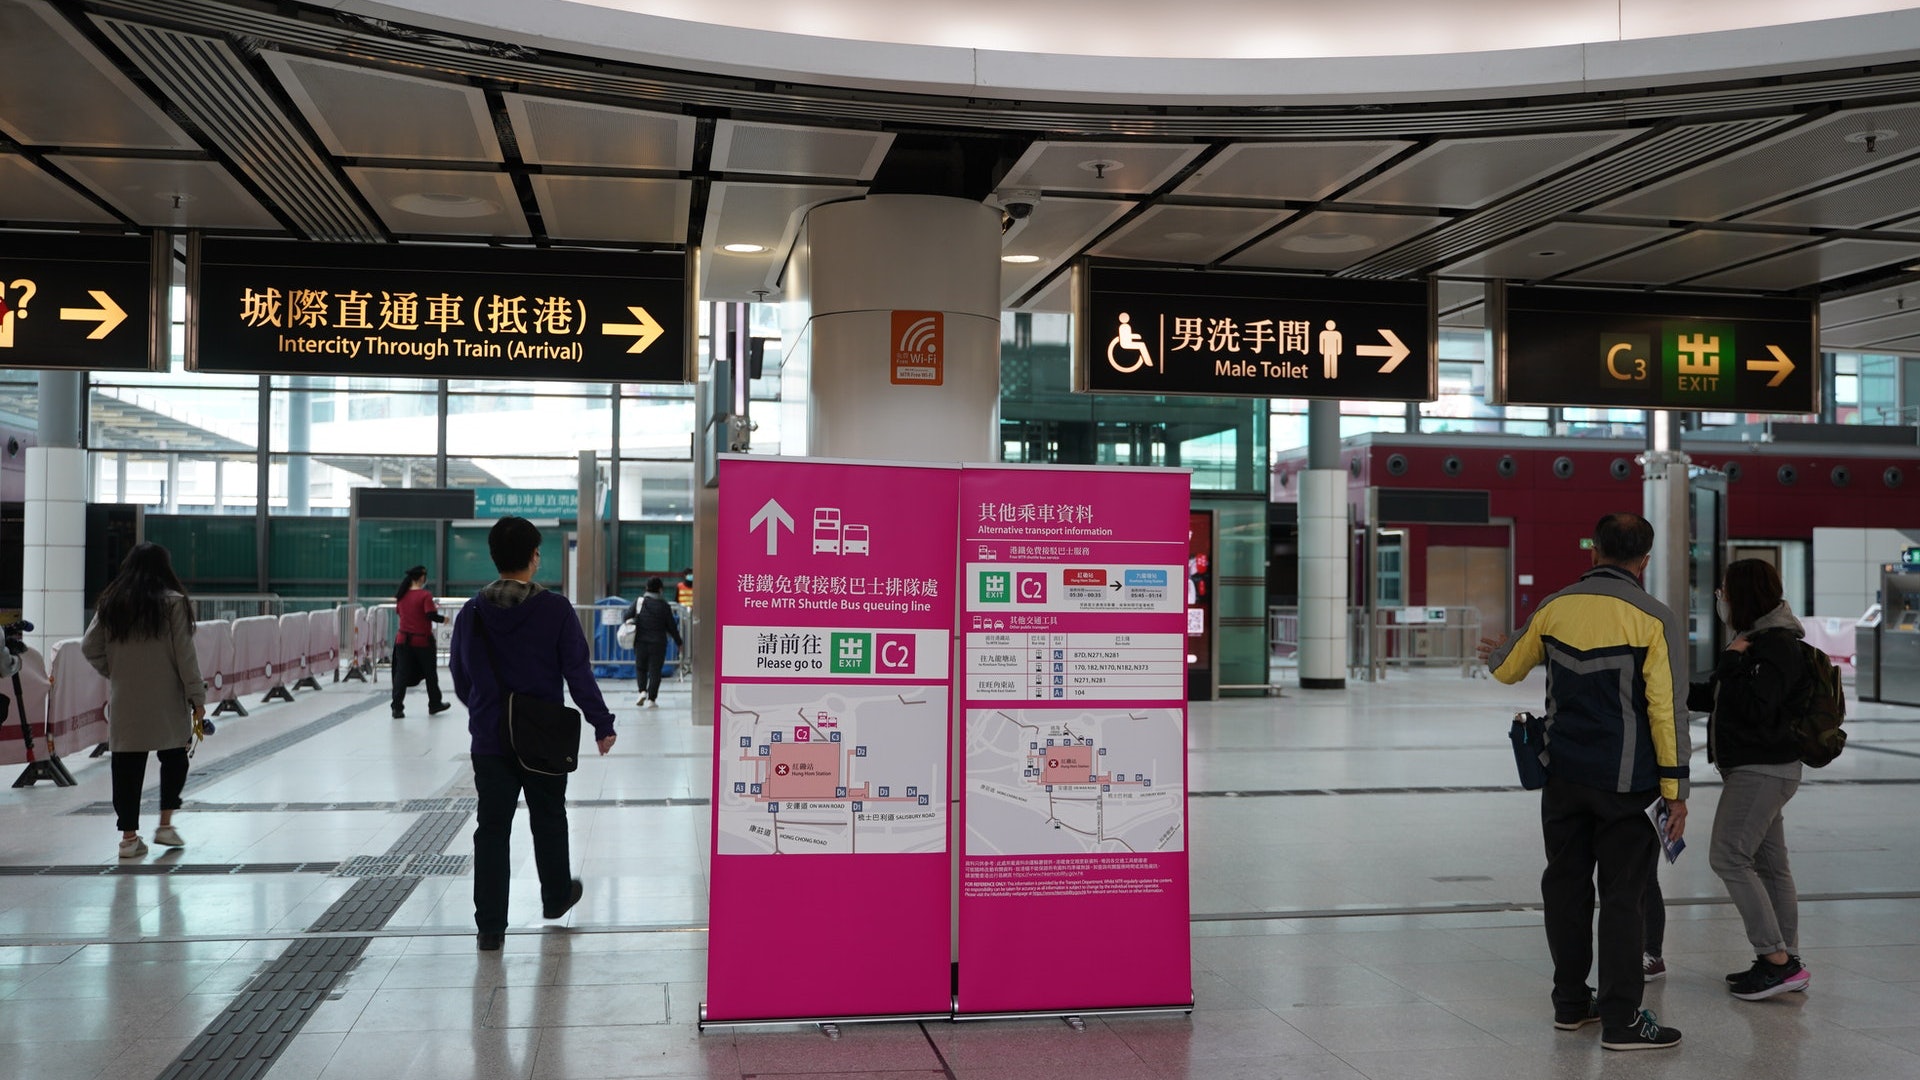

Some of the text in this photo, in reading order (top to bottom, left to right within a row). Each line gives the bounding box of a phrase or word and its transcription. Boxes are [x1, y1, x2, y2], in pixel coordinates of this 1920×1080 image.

[239, 287, 587, 335] 城際直通車(抵港)
[1171, 316, 1310, 355] 男洗手間
[278, 334, 584, 363] Intercity Through Train (Arrival)
[910, 353, 937, 364] Wi-Fi
[1607, 342, 1647, 381] C3
[1215, 359, 1309, 379] Male Toilet
[1678, 376, 1719, 392] EXIT
[978, 503, 1094, 524] 其他乘車資料
[978, 525, 1113, 536] Alternative transport information
[736, 574, 938, 597] 港鐵免費接駁巴士排隊處
[1020, 578, 1042, 599] C2
[744, 598, 931, 613] Free MTR Shuttle Bus queuing line
[1010, 616, 1058, 625] 其他交通工具
[757, 633, 822, 655] 請前往
[881, 640, 908, 668] C2
[756, 657, 822, 672] Please go to
[839, 660, 862, 668] EXIT
[772, 733, 781, 741] C1
[796, 729, 807, 740] C2
[741, 738, 750, 746] B1
[760, 747, 769, 755] B2
[856, 748, 866, 756] D2
[735, 784, 745, 792] A3
[751, 784, 761, 793] A2
[880, 788, 889, 797] D3
[907, 788, 917, 797] D4
[768, 803, 778, 812] A1
